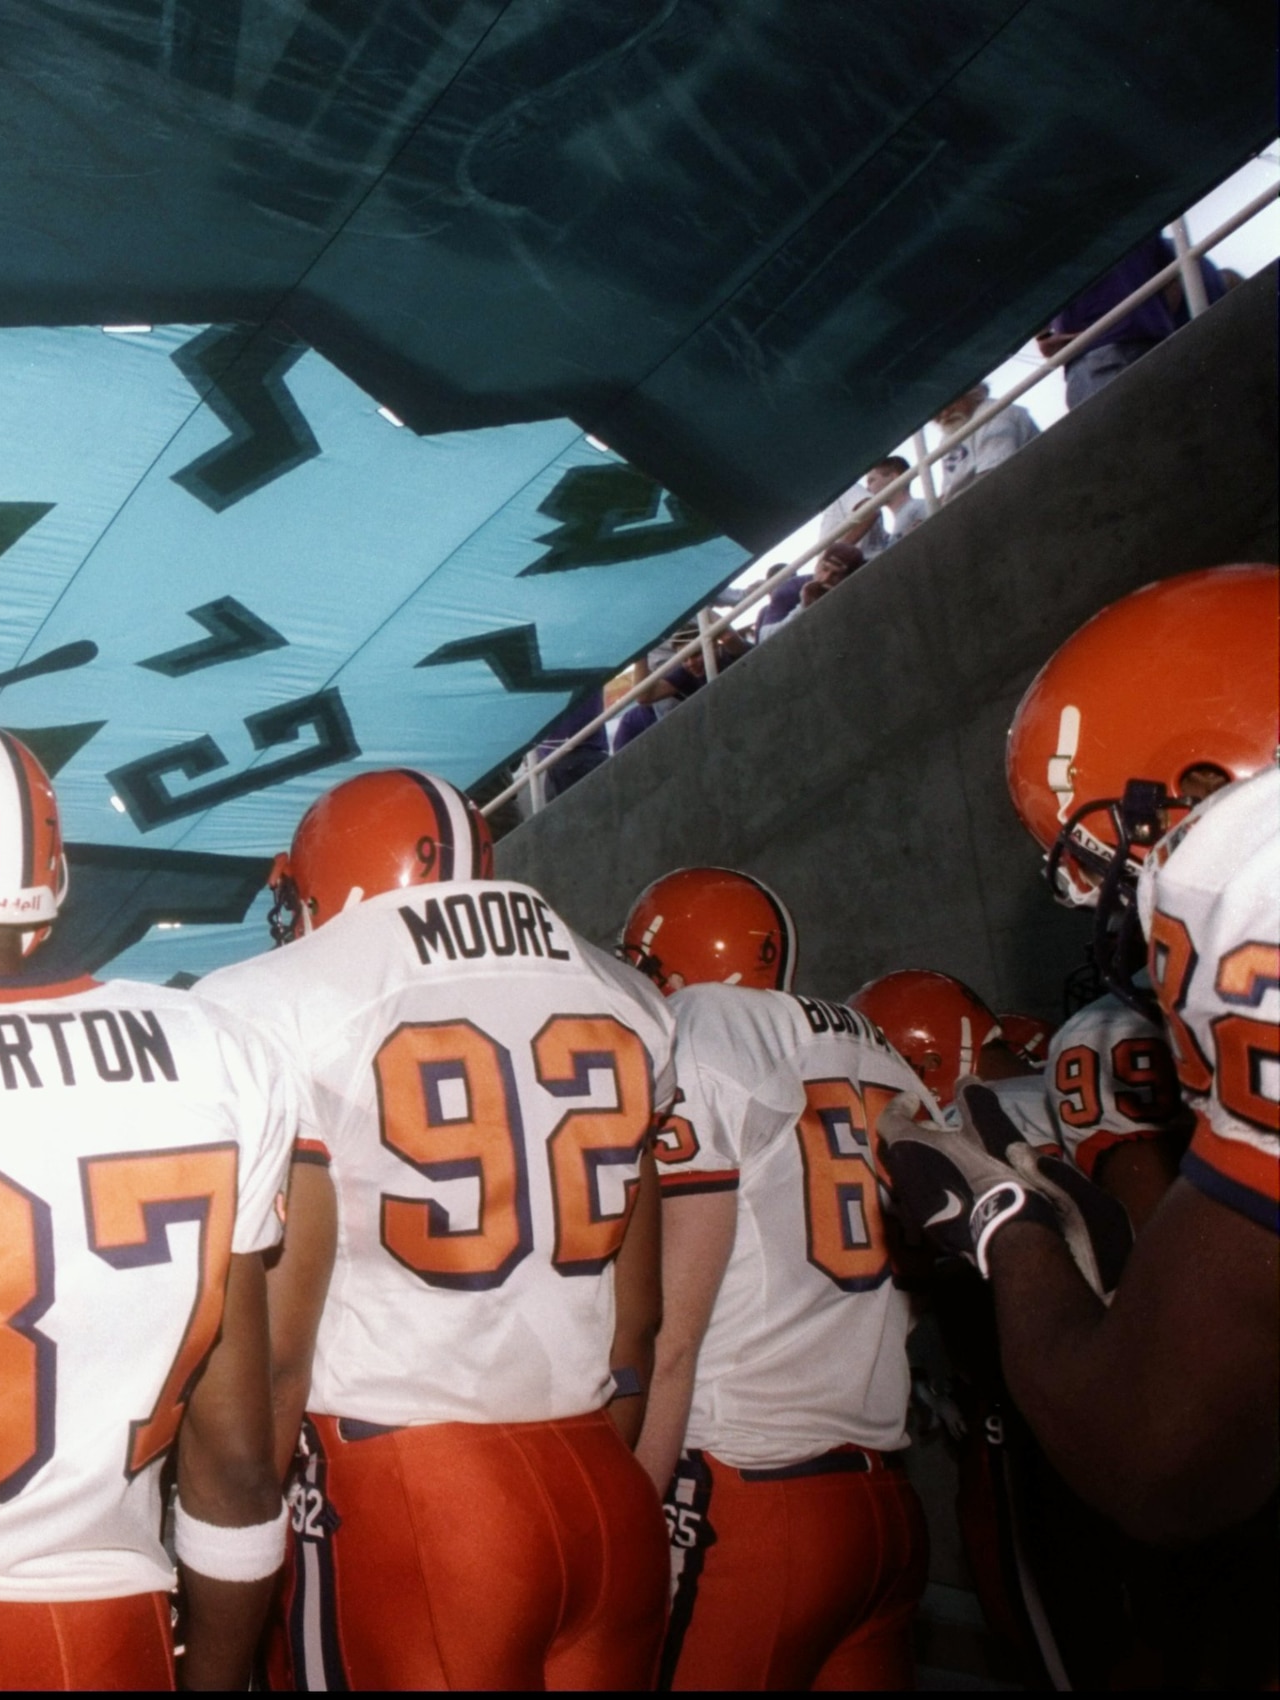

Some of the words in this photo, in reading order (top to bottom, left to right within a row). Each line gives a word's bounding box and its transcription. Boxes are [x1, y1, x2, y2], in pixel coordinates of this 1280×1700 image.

[416, 835, 437, 878] 9
[398, 890, 571, 965] MOORE
[759, 929, 778, 964] 6
[372, 1013, 656, 1292] 92
[984, 1414, 1005, 1446] 9
[291, 1486, 325, 1539] 92
